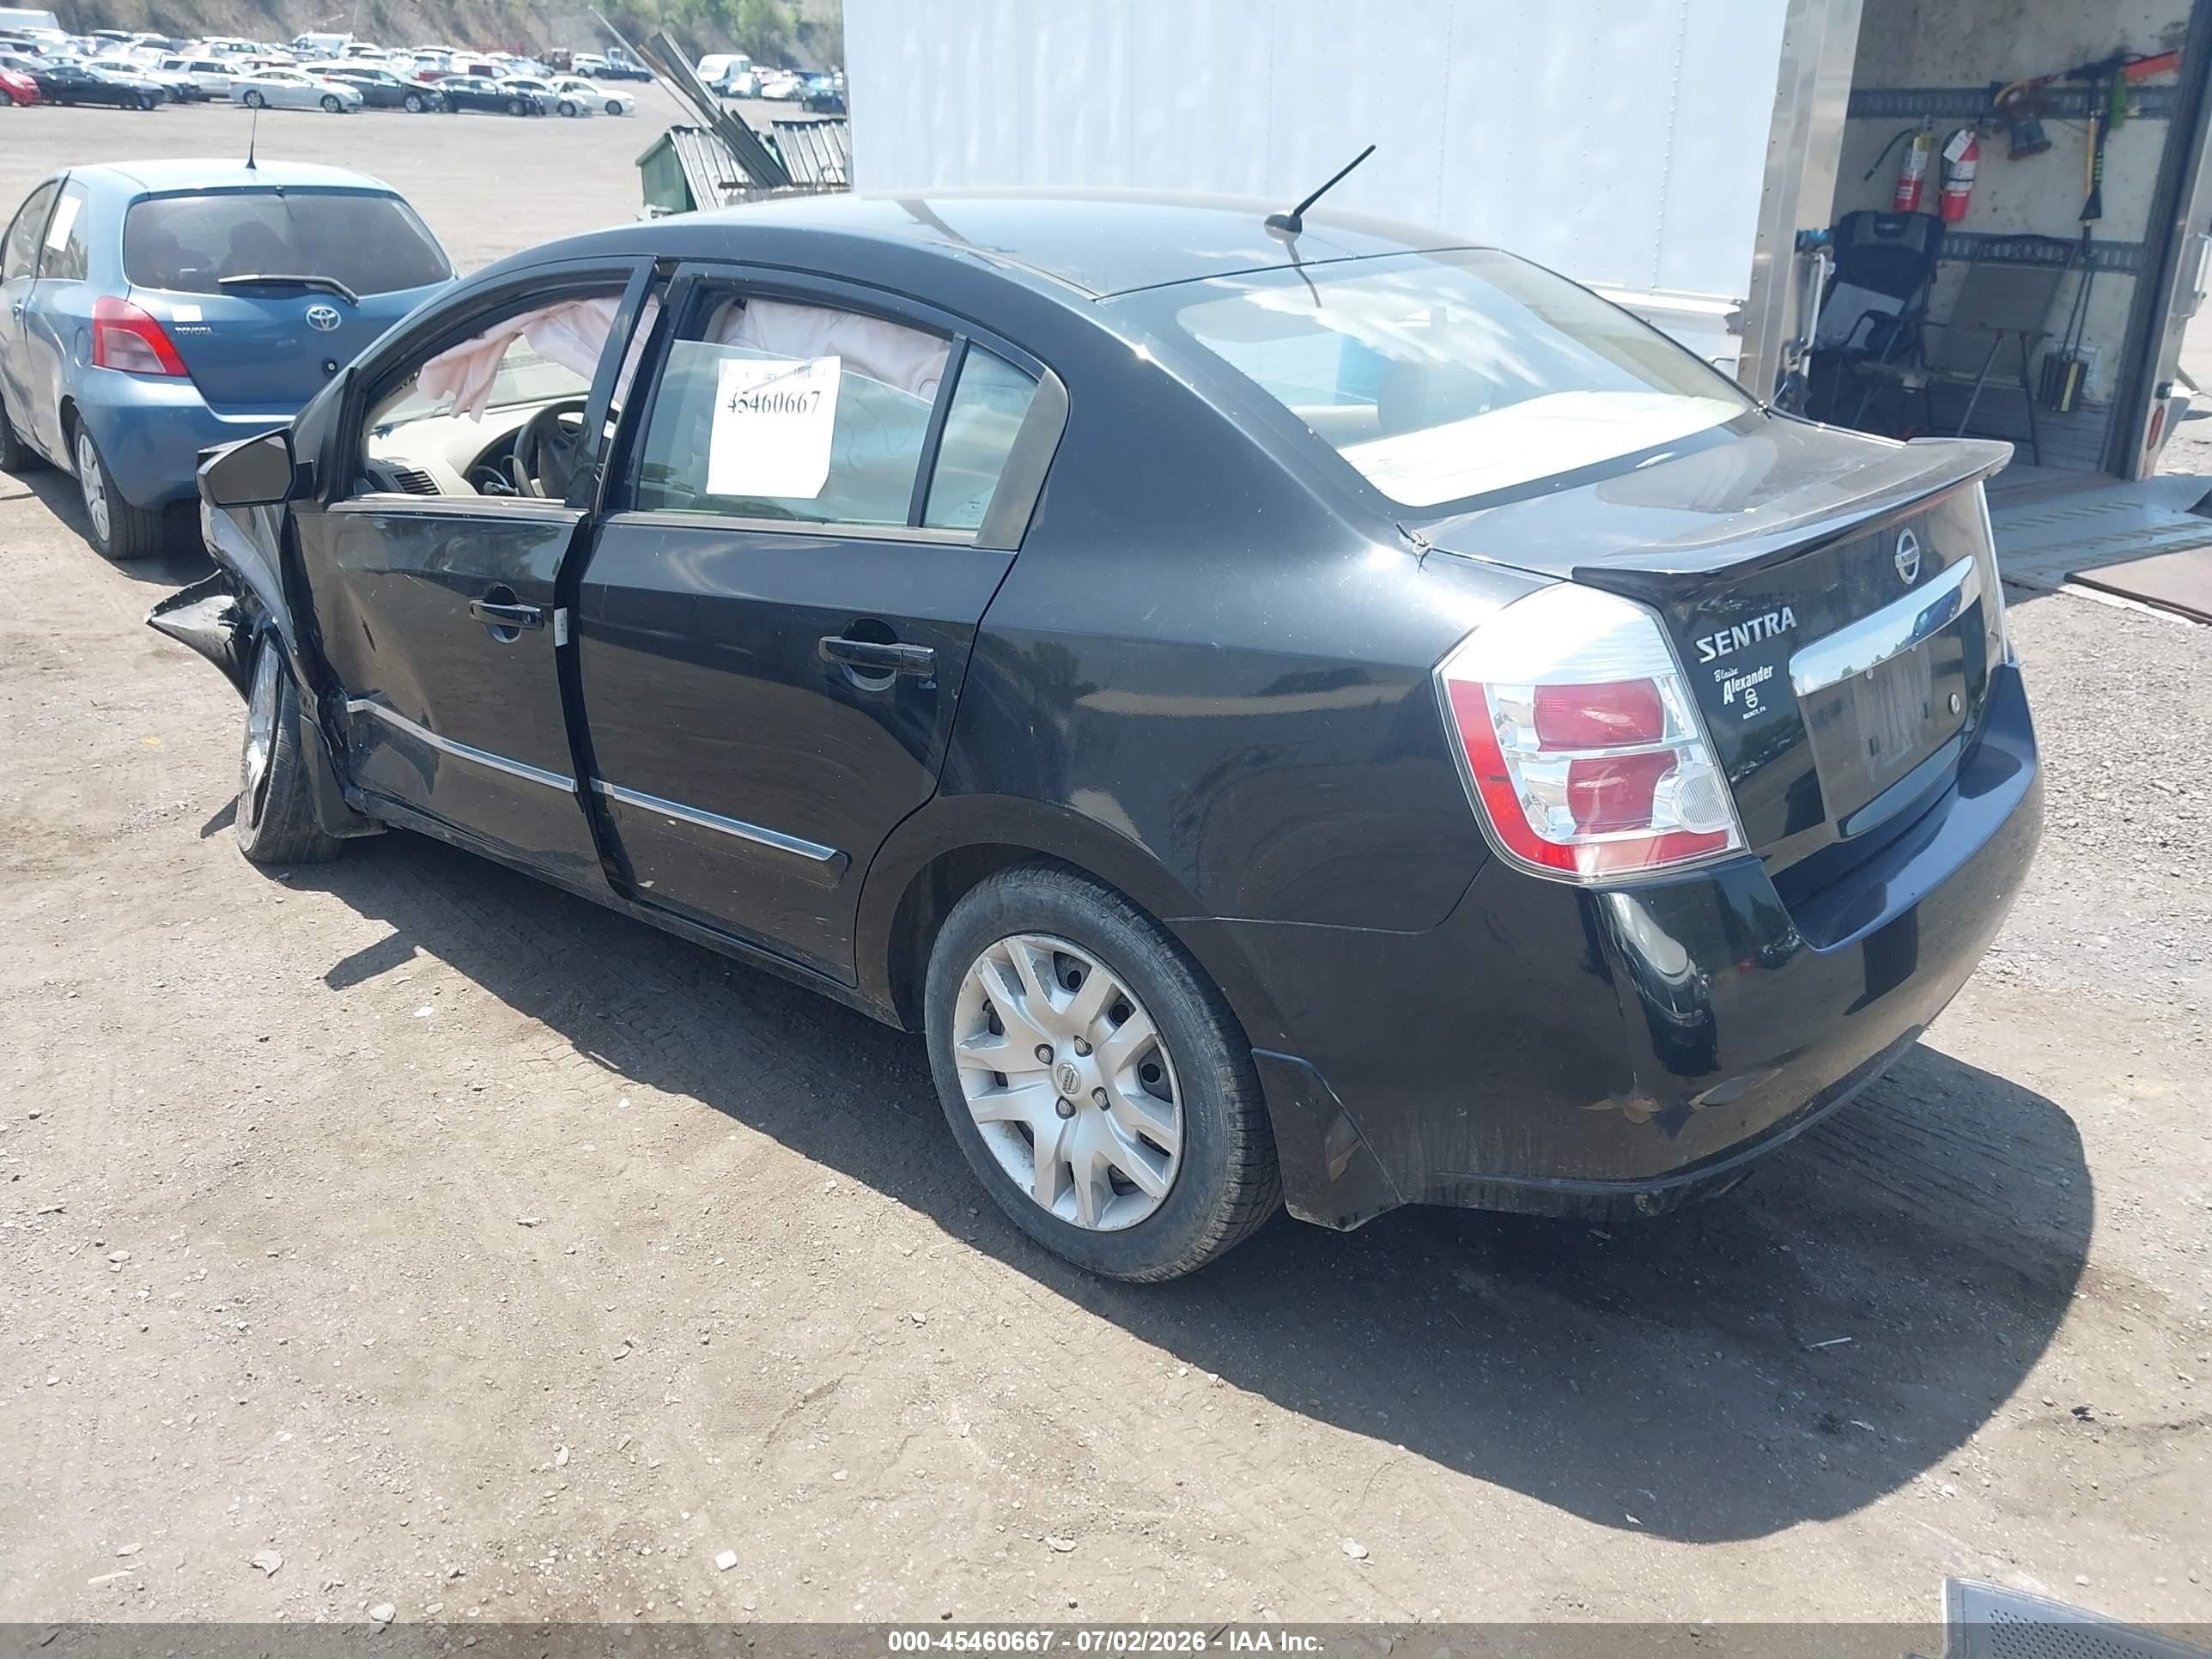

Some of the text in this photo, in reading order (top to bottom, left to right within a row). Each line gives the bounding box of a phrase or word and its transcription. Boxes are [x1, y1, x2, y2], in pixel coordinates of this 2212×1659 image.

[174, 326, 213, 336] TOYOTA
[727, 390, 822, 415] 45460667
[1695, 606, 1798, 665] SENTRA
[1723, 665, 1774, 705] Alexander
